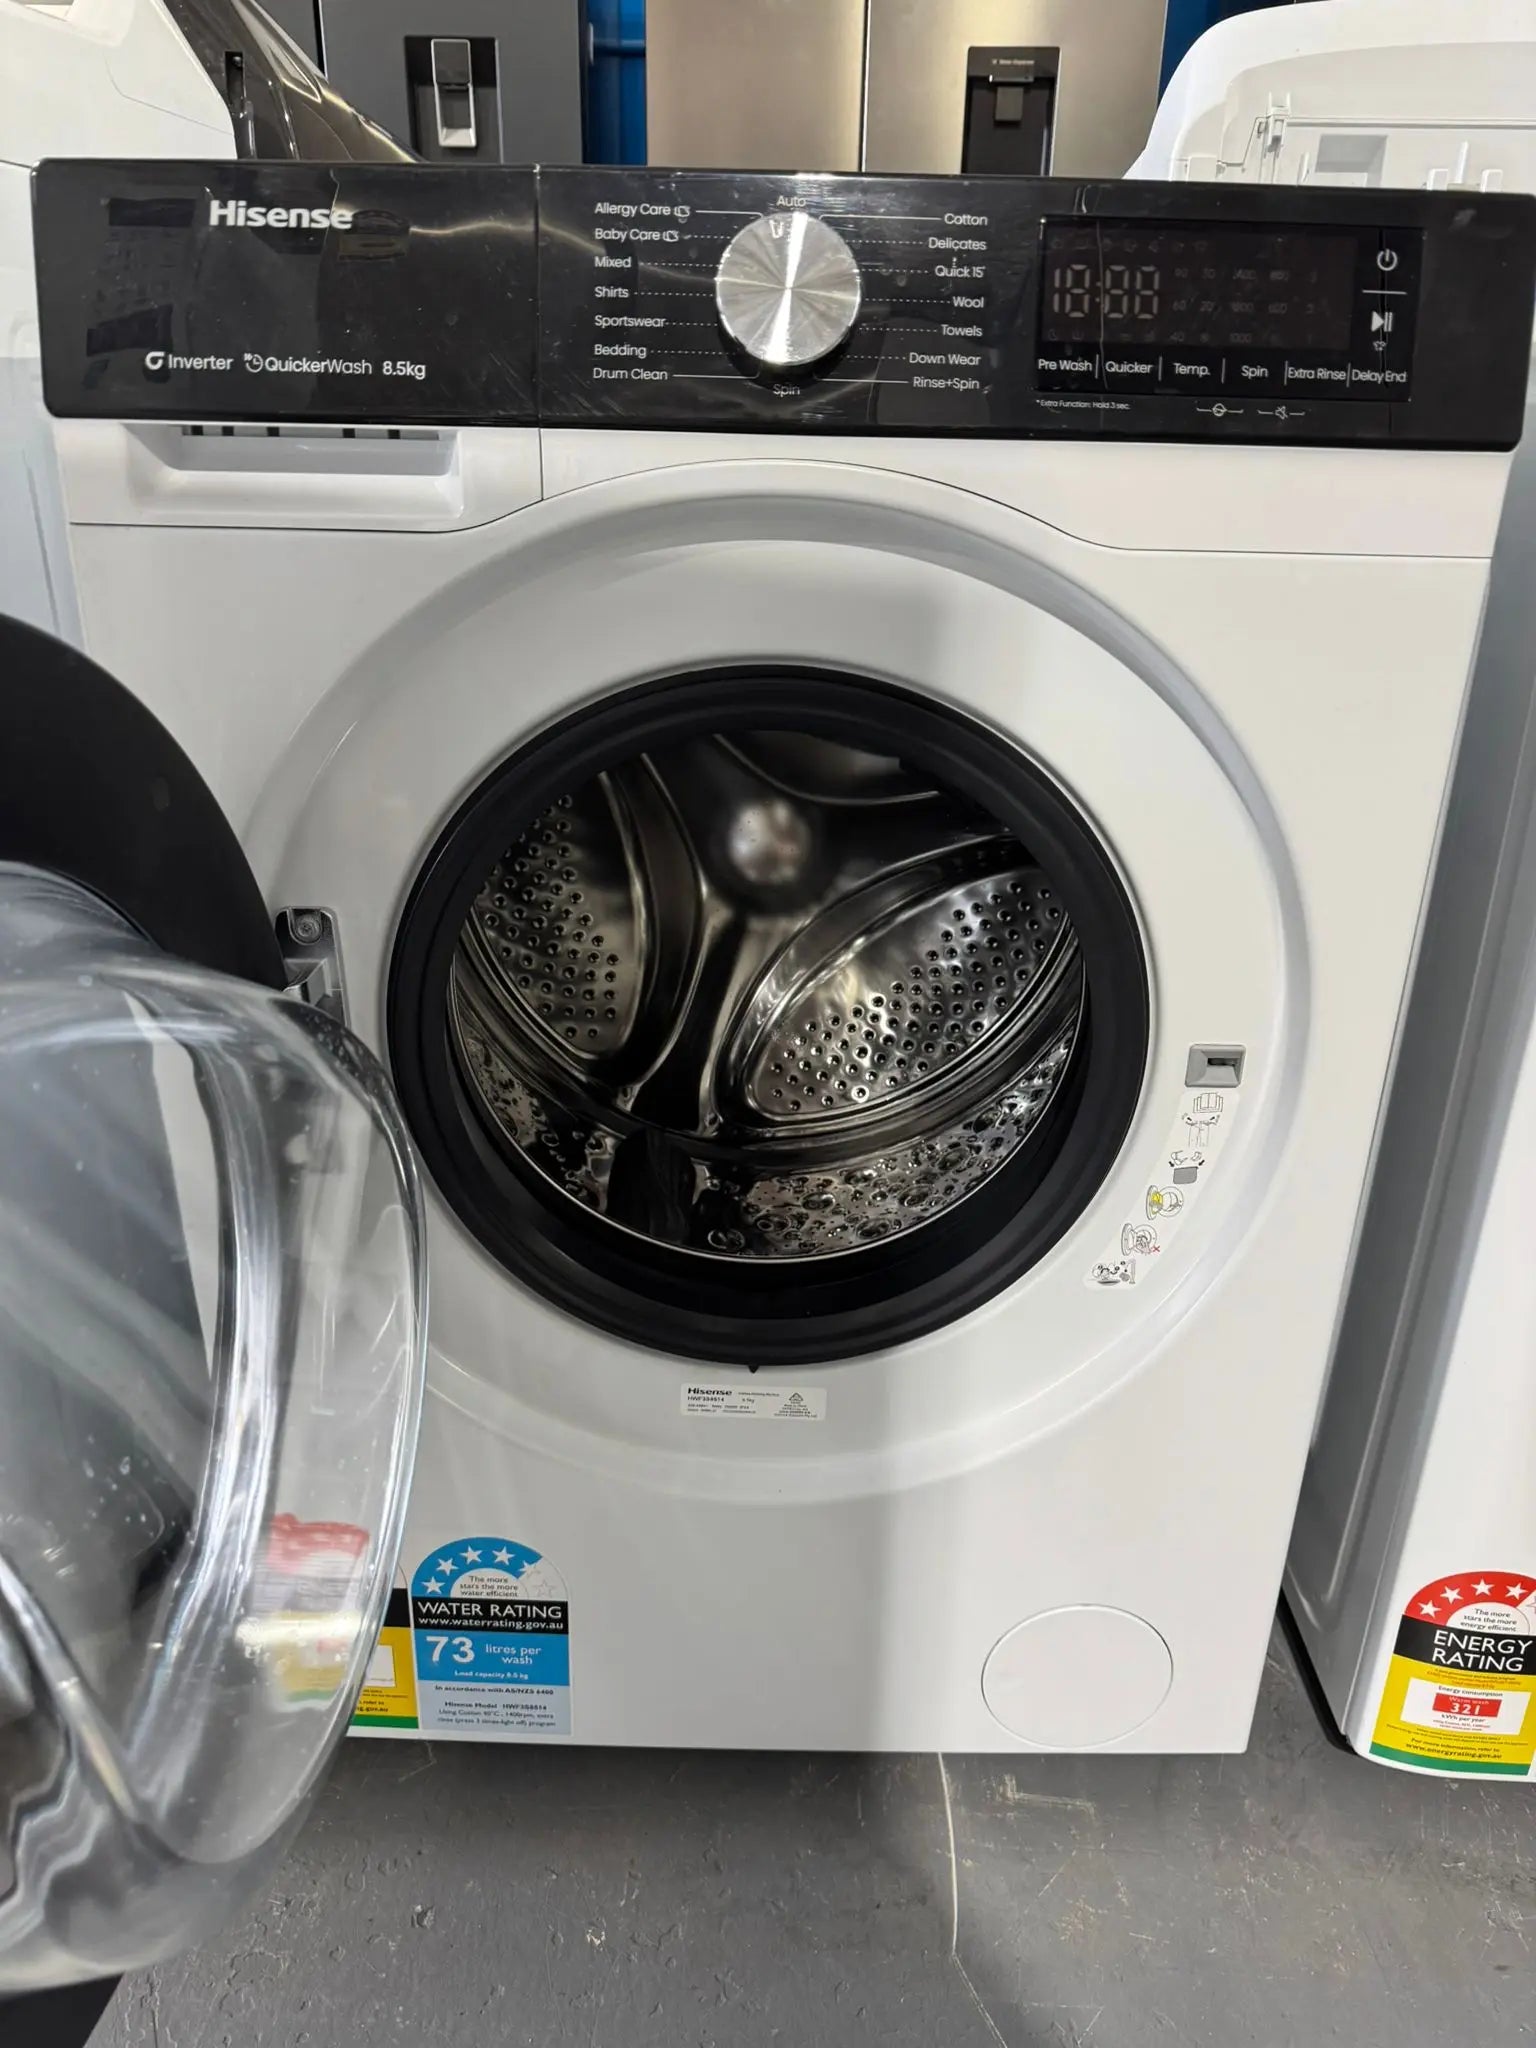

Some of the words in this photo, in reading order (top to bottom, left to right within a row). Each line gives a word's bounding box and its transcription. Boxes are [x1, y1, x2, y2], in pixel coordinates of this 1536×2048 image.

[776, 195, 807, 207] Auto
[209, 199, 353, 230] Hisense
[594, 202, 638, 217] Allergy
[640, 203, 671, 215] Care
[944, 213, 988, 226] Cotton
[594, 228, 628, 243] Baby
[630, 229, 660, 241] Care
[928, 237, 987, 250] Delicates
[594, 256, 632, 268] Mixed
[935, 265, 970, 278] Quick
[594, 286, 629, 298] Shirts
[952, 296, 984, 308] Wool
[594, 315, 666, 328] Sportswear
[941, 324, 983, 337] Towels
[594, 344, 647, 359] Bedding
[168, 354, 234, 371] Inverter
[909, 352, 946, 364] Down
[947, 353, 981, 365] Wear
[265, 356, 372, 375] QuickerWash
[382, 360, 426, 380] 8.5kg
[1038, 359, 1057, 370] Pre
[1059, 360, 1092, 372] Wash
[1105, 361, 1153, 373] Quicker
[1173, 362, 1210, 377] Temp.
[1241, 365, 1268, 379] Spin
[593, 367, 628, 379] Drum
[631, 368, 668, 380] Clean
[1288, 367, 1315, 380] Extra
[1317, 368, 1346, 380] Rinse
[1351, 369, 1383, 384] Delay
[1385, 371, 1407, 383] End
[772, 383, 800, 397] Spin
[913, 376, 980, 391] Rinse+Spin
[1093, 401, 1109, 409] Hold
[688, 1387, 732, 1396] Hisense
[469, 1575, 484, 1583] The
[418, 1601, 486, 1617] WATER
[490, 1604, 562, 1619] RATING
[1475, 1608, 1489, 1616] The
[418, 1617, 564, 1630] www.waterrating.gov.au
[1460, 1621, 1486, 1630] energy
[1487, 1624, 1516, 1632] efficient
[1433, 1629, 1533, 1655] ENERGY
[425, 1635, 475, 1663] 73
[485, 1643, 517, 1655] litres
[520, 1646, 542, 1659] per
[501, 1655, 533, 1665] wash
[1432, 1647, 1524, 1672] RATING
[1438, 1685, 1460, 1694] Energy
[1450, 1703, 1480, 1715] 321
